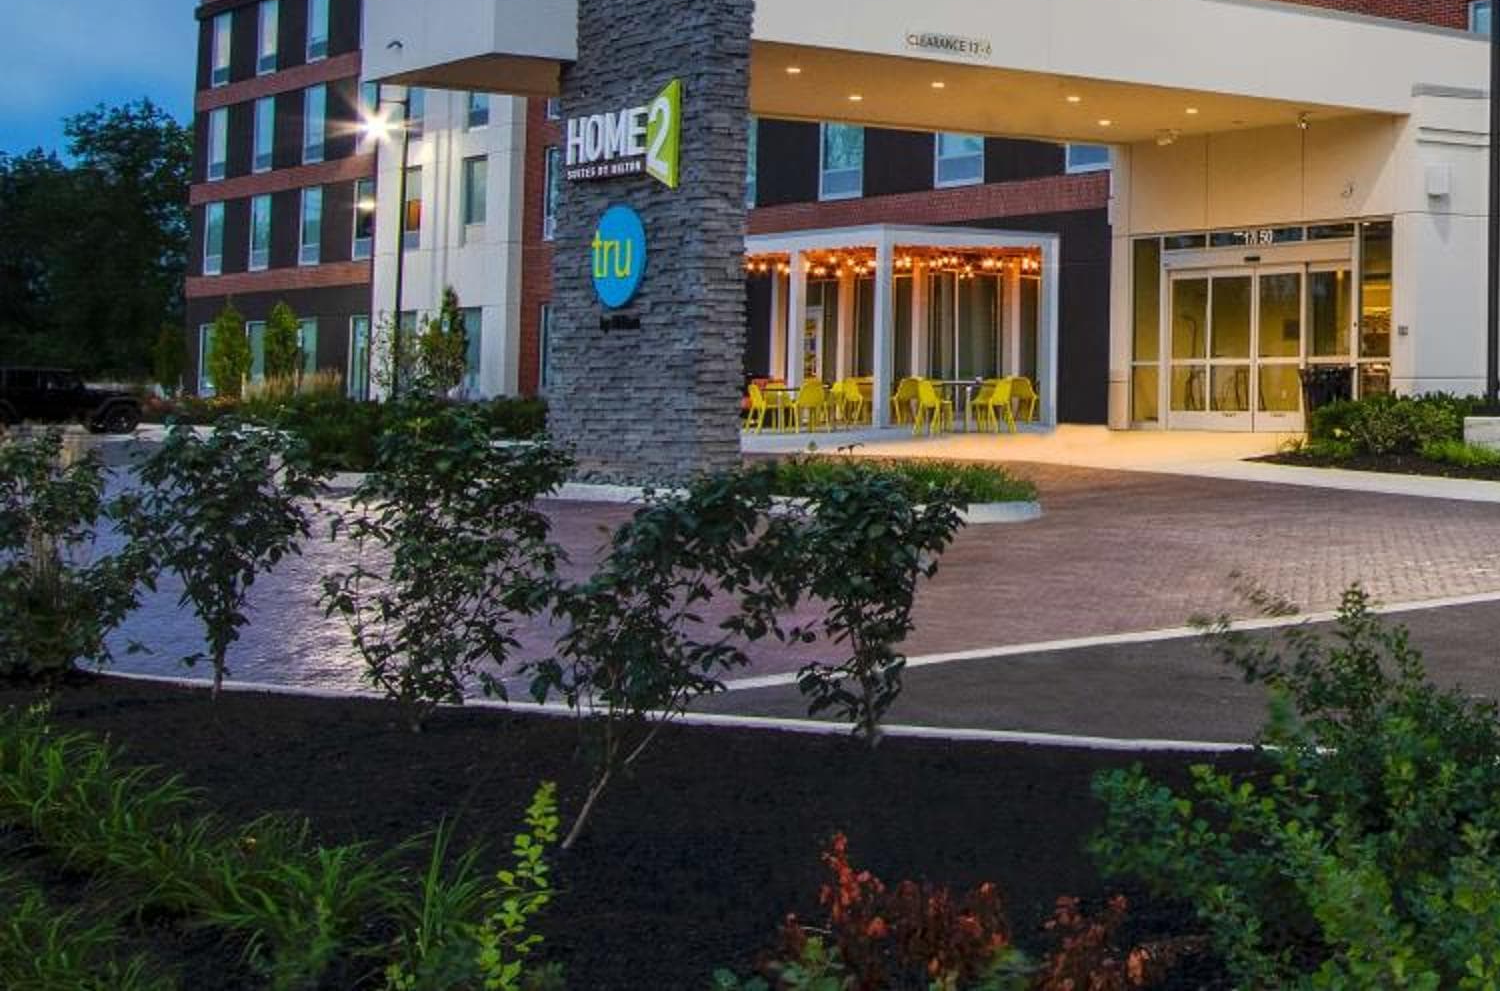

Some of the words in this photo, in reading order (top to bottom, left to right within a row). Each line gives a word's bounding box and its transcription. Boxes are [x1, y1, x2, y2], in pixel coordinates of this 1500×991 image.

[907, 34, 966, 51] CLEARANCE
[567, 166, 596, 180] SUITES
[591, 230, 632, 278] tru
